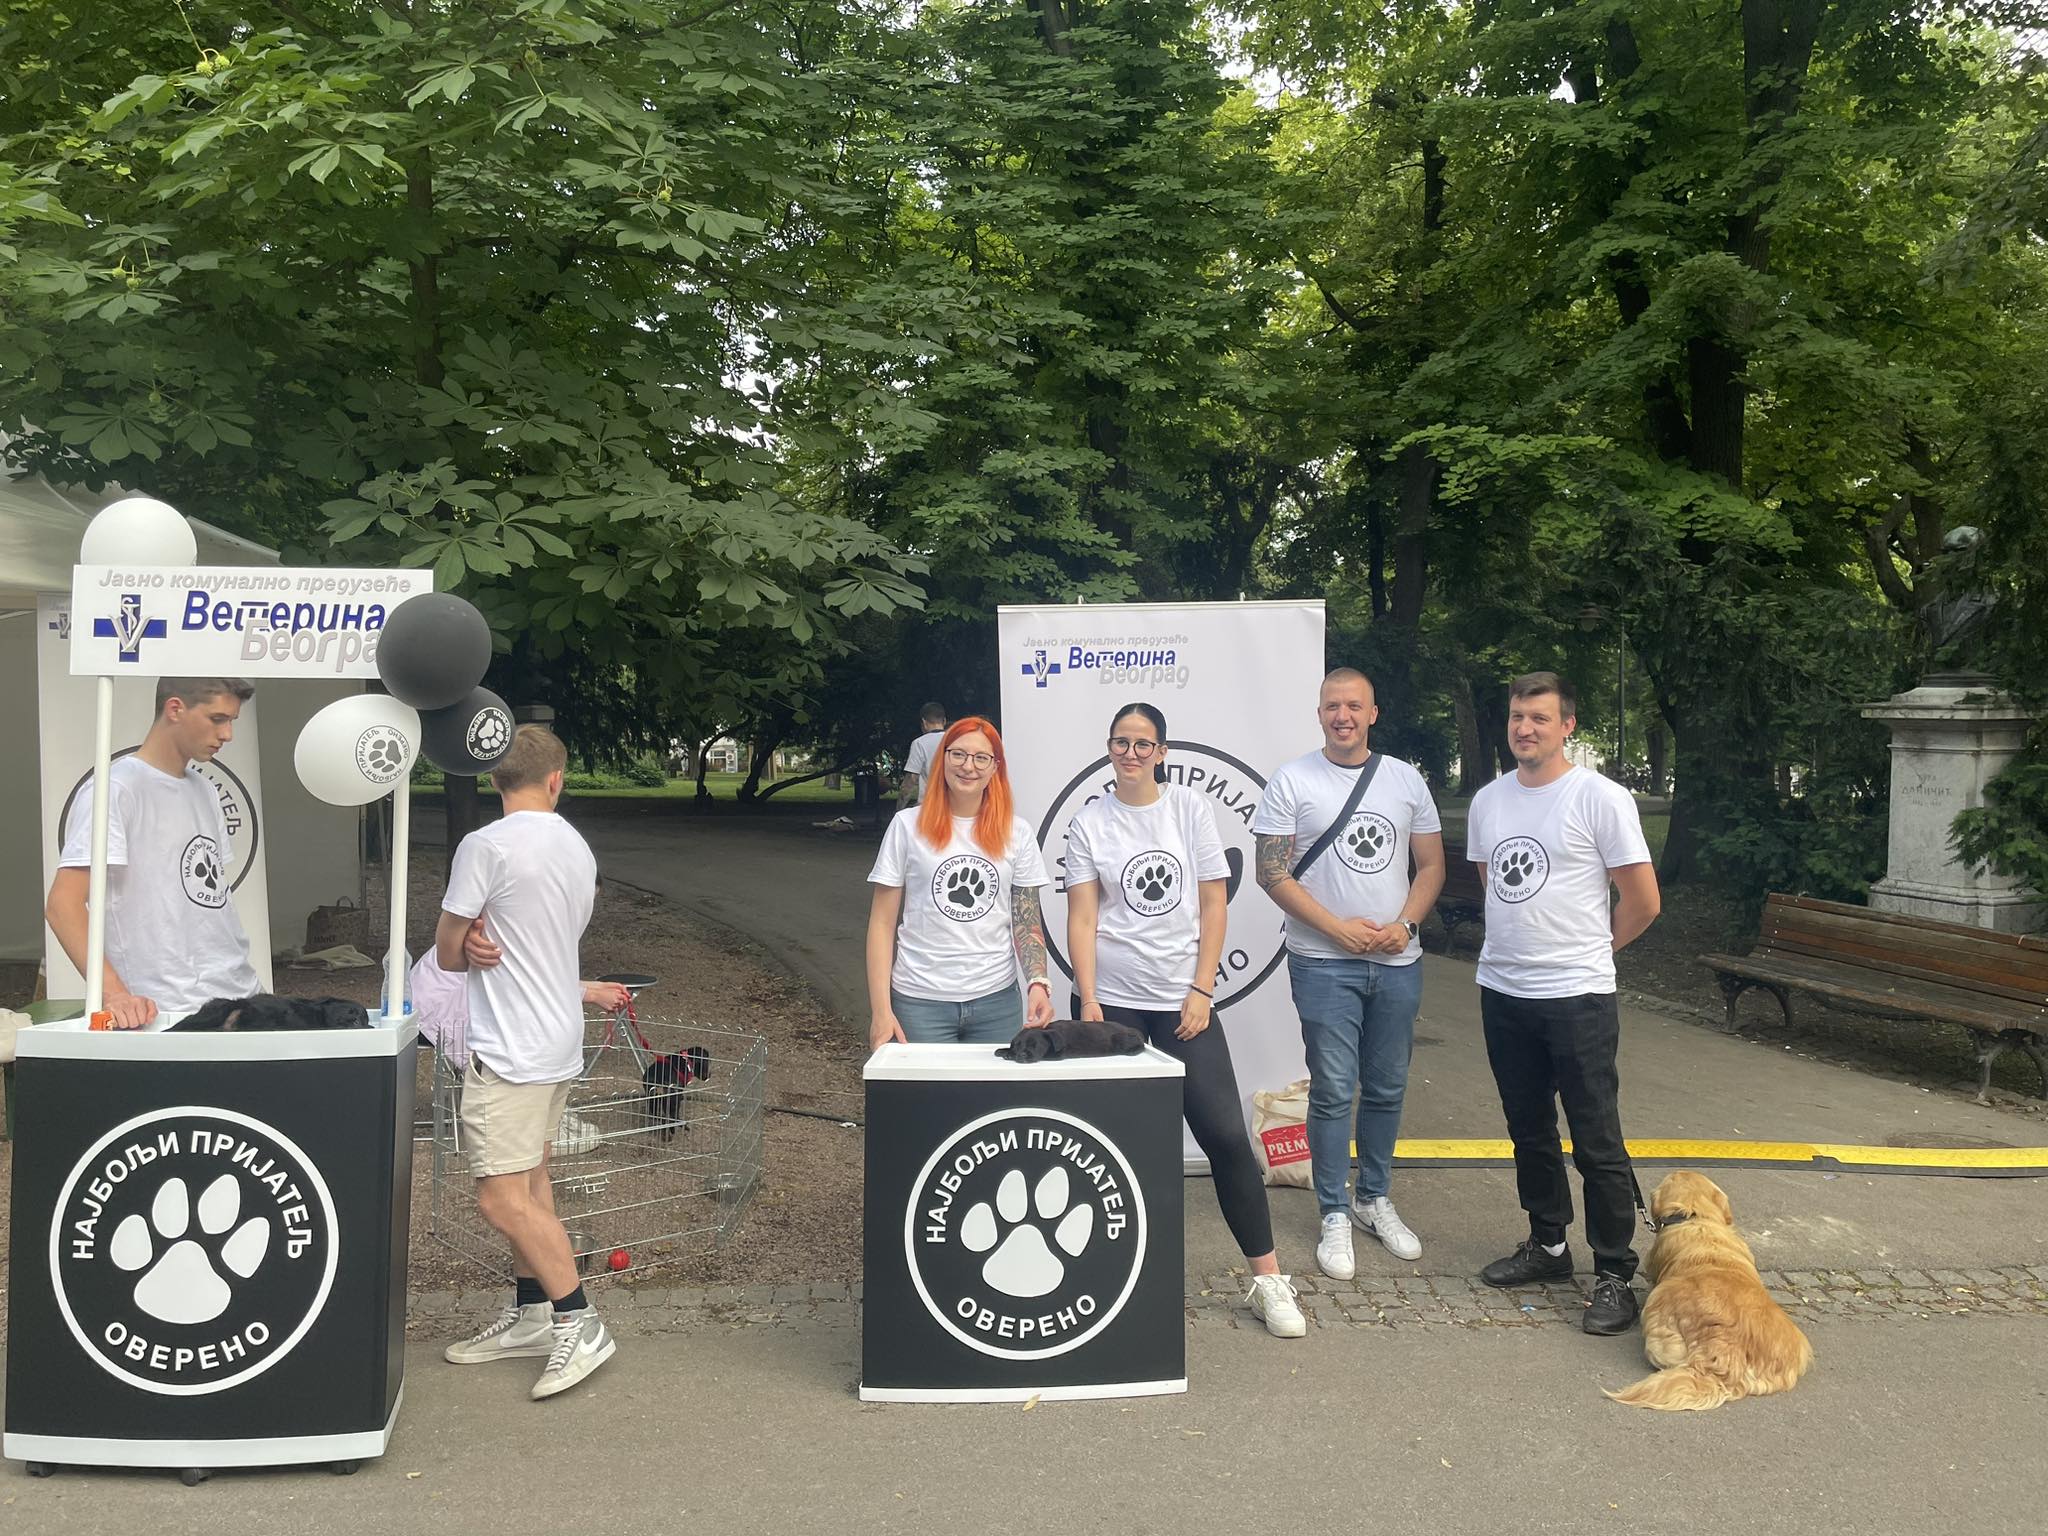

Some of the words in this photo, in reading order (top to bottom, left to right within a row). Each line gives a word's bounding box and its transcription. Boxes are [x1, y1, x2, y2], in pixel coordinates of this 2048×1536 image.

[99, 569, 164, 589] Јавно
[169, 574, 292, 593] комунално
[296, 574, 412, 596] предузеће
[181, 590, 386, 636] Ветерина
[240, 619, 379, 673] Београ
[1060, 636, 1125, 648] комунално
[1068, 646, 1176, 670] Ветерина
[1100, 661, 1190, 689] Београд
[1126, 856, 1150, 889] НАЈБОЉИ
[1347, 856, 1385, 869] ОВЕРЕНО
[935, 857, 967, 894] НАЈБОЉИ
[969, 857, 997, 900] ПРИЈАТЕЉ
[1497, 884, 1531, 898] ОВЕРЕНО
[944, 905, 984, 919] ОВЕРЕНО
[1136, 898, 1174, 912] ОВЕРЕНО
[72, 1131, 180, 1260] НАЈБОЉИ
[190, 1130, 312, 1260] ПРИЈАТЕЉ
[926, 1129, 1019, 1243] НАЈБОЉИ
[1027, 1129, 1127, 1241] ПРИЈАТЕЉ
[957, 1294, 1096, 1339] ОВЕРЕНО
[104, 1321, 270, 1372] ОВЕРЕНО
